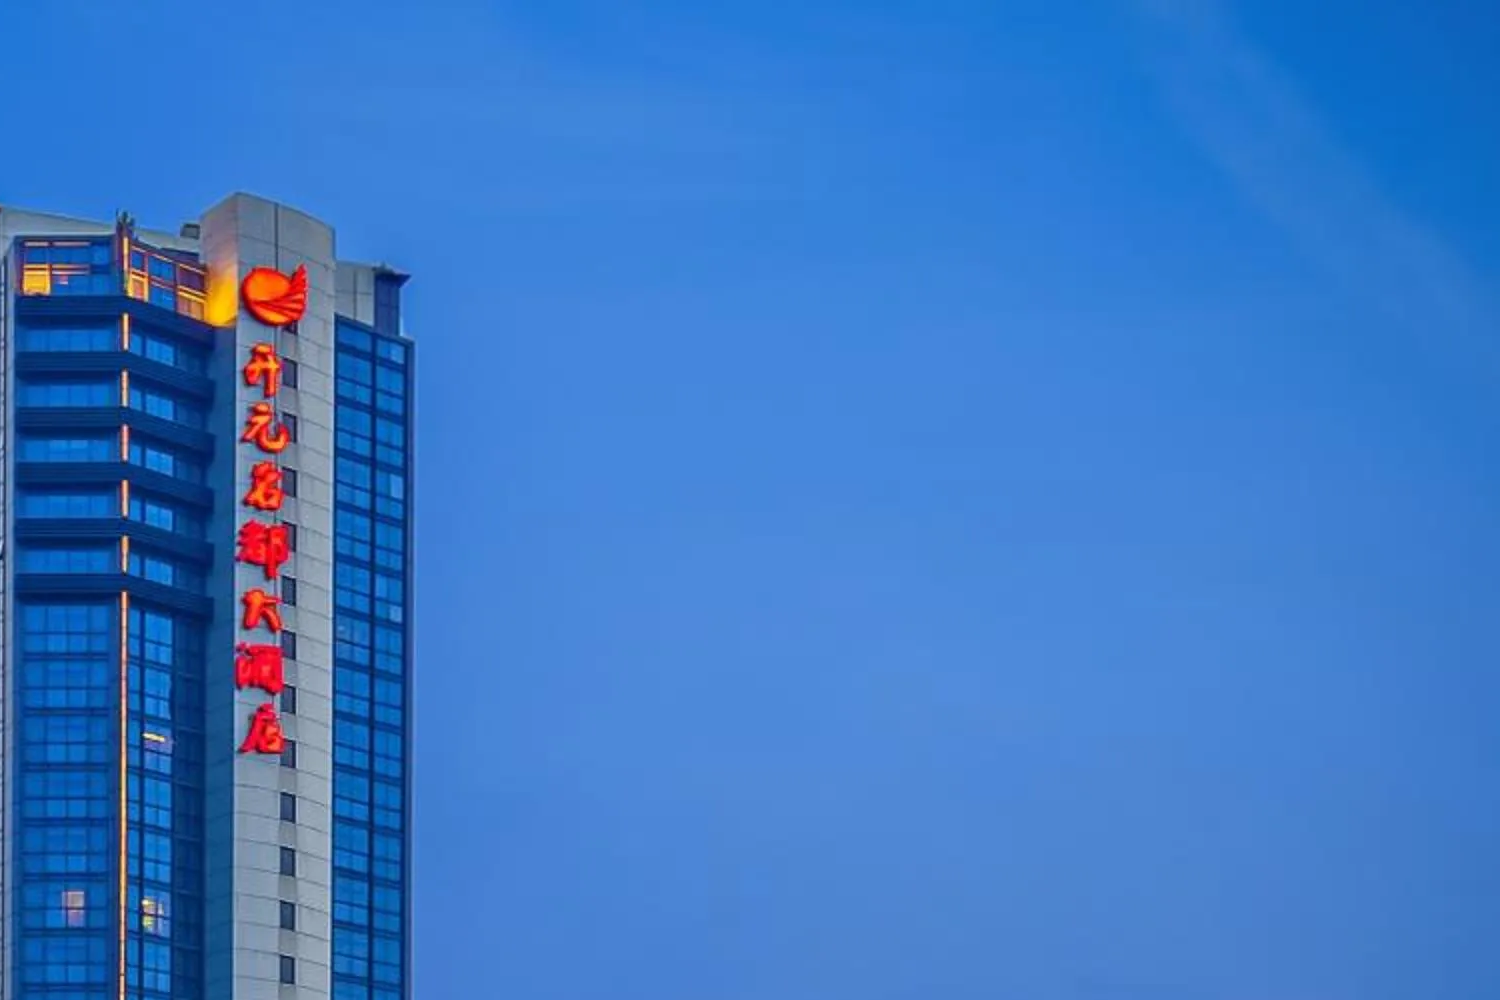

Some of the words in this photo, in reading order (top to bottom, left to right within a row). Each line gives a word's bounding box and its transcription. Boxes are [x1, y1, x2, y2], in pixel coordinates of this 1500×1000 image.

[235, 342, 290, 755] 开元名都大酒店
